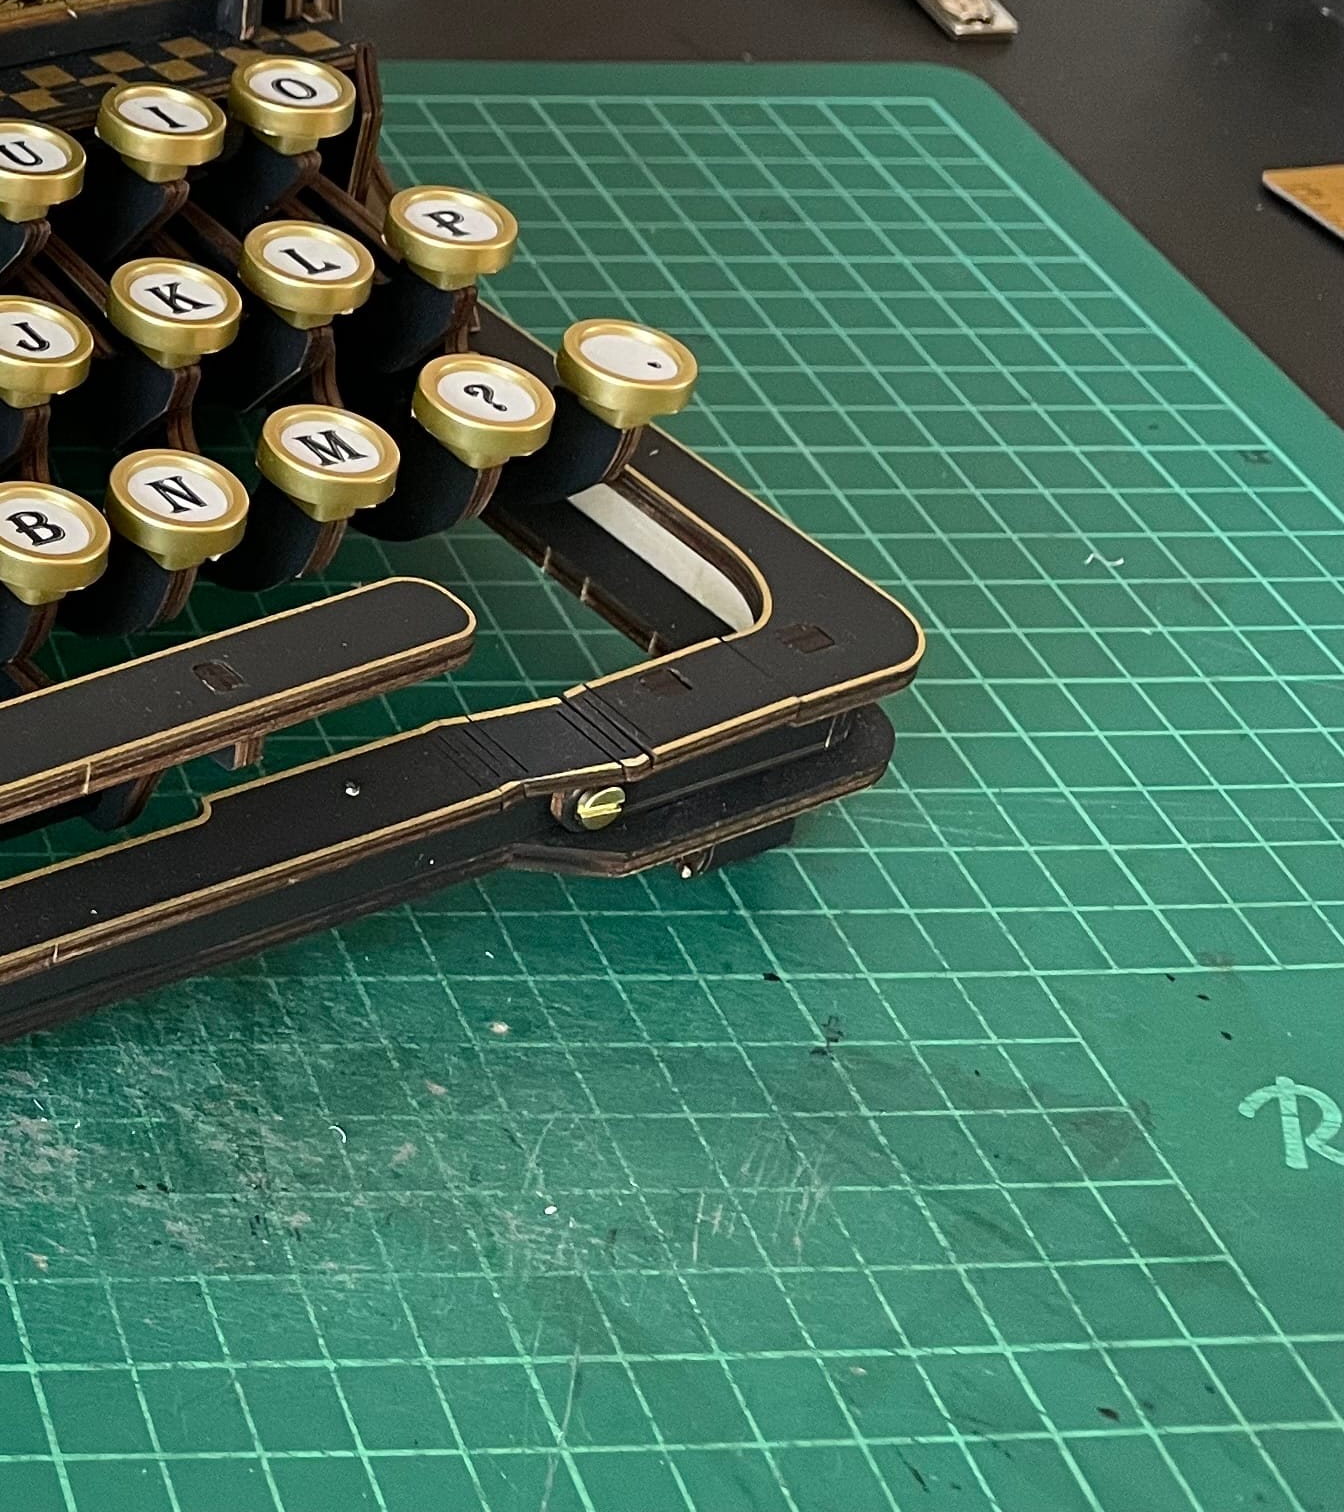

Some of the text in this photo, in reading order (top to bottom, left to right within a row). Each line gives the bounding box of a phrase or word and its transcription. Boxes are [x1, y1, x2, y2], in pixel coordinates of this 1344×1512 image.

[143, 106, 187, 129] I
[271, 78, 318, 100] O
[12, 321, 51, 352] J
[145, 282, 213, 314] K
[279, 248, 341, 275] L
[424, 210, 469, 237] P
[5, 511, 66, 547] B
[145, 475, 207, 514] N
[293, 430, 368, 467] M
[463, 384, 508, 412] ?
